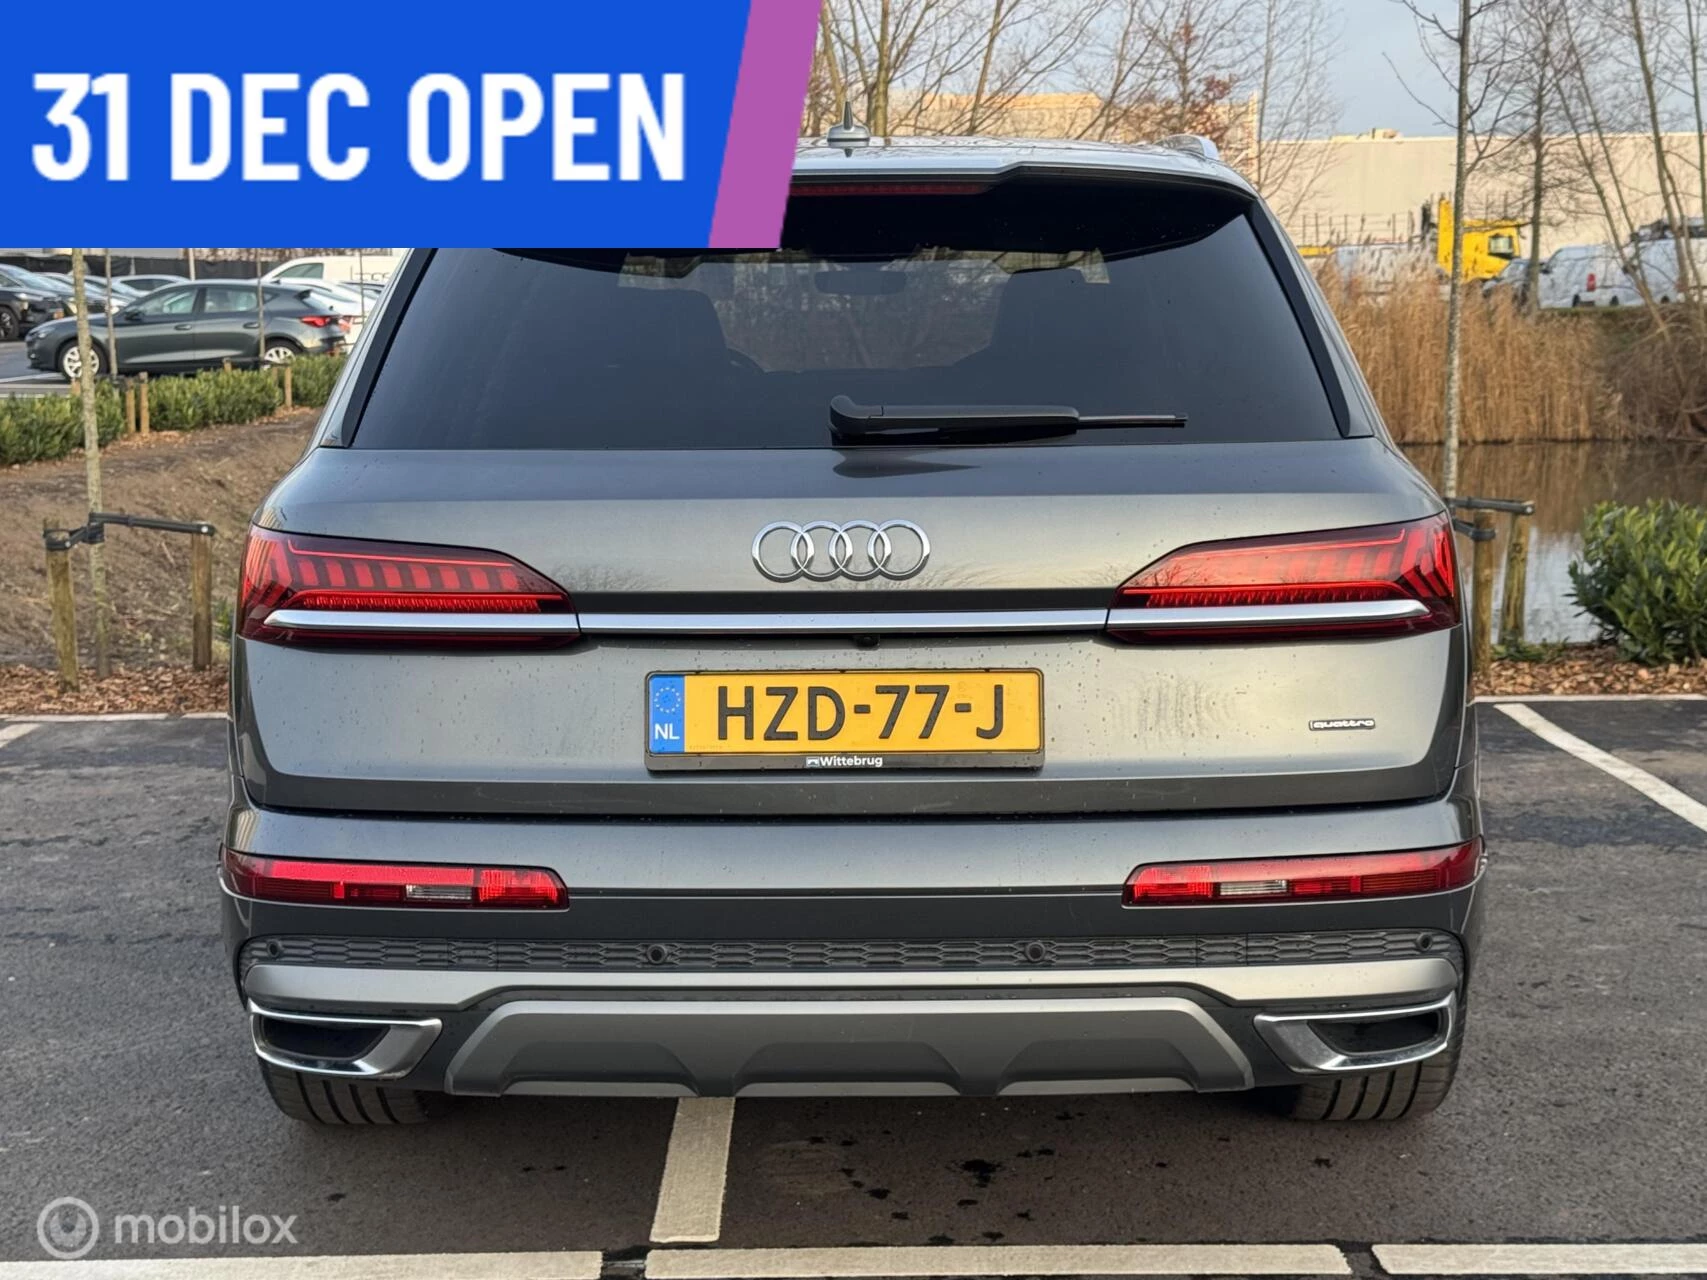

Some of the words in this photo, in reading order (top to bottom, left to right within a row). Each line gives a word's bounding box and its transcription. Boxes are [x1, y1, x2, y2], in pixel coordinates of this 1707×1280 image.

[717, 684, 1005, 741] HZD-77-J
[1312, 719, 1375, 729] quattro
[654, 723, 681, 741] NL
[819, 756, 883, 768] Wittebrug
